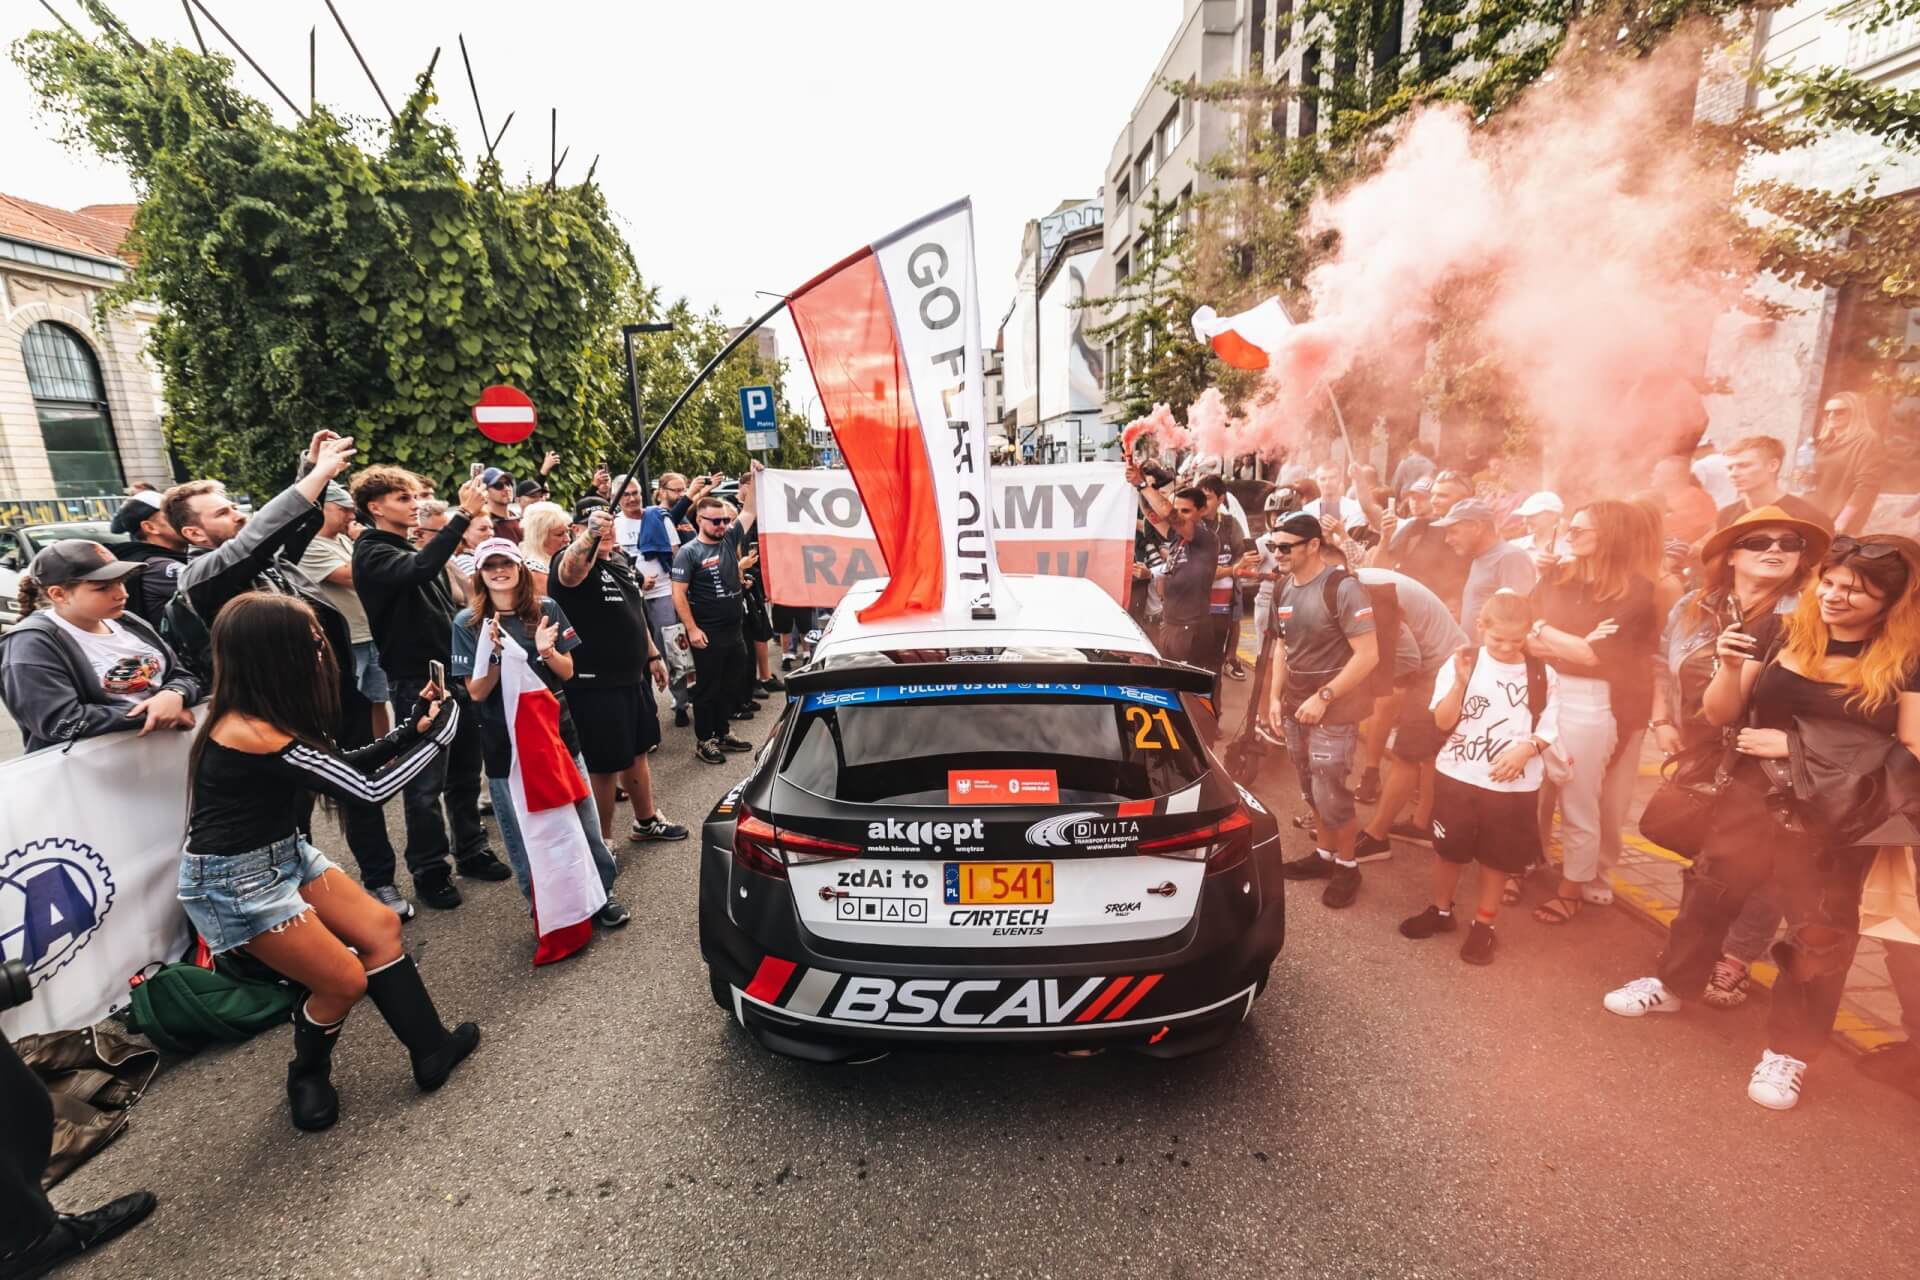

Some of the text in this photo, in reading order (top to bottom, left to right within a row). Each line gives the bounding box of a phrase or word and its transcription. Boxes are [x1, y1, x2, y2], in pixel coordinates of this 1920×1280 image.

[907, 242, 961, 330] GO
[747, 390, 767, 419] P
[1125, 706, 1180, 750] 21
[1077, 821, 1139, 836] DIVITA
[902, 869, 928, 889] to
[992, 867, 1042, 899] 541
[946, 888, 958, 897] PL
[949, 909, 1049, 926] CARTECH
[1104, 901, 1142, 914] SROKA
[992, 927, 1044, 936] EVENTS
[831, 976, 1105, 1025] BSCAV
